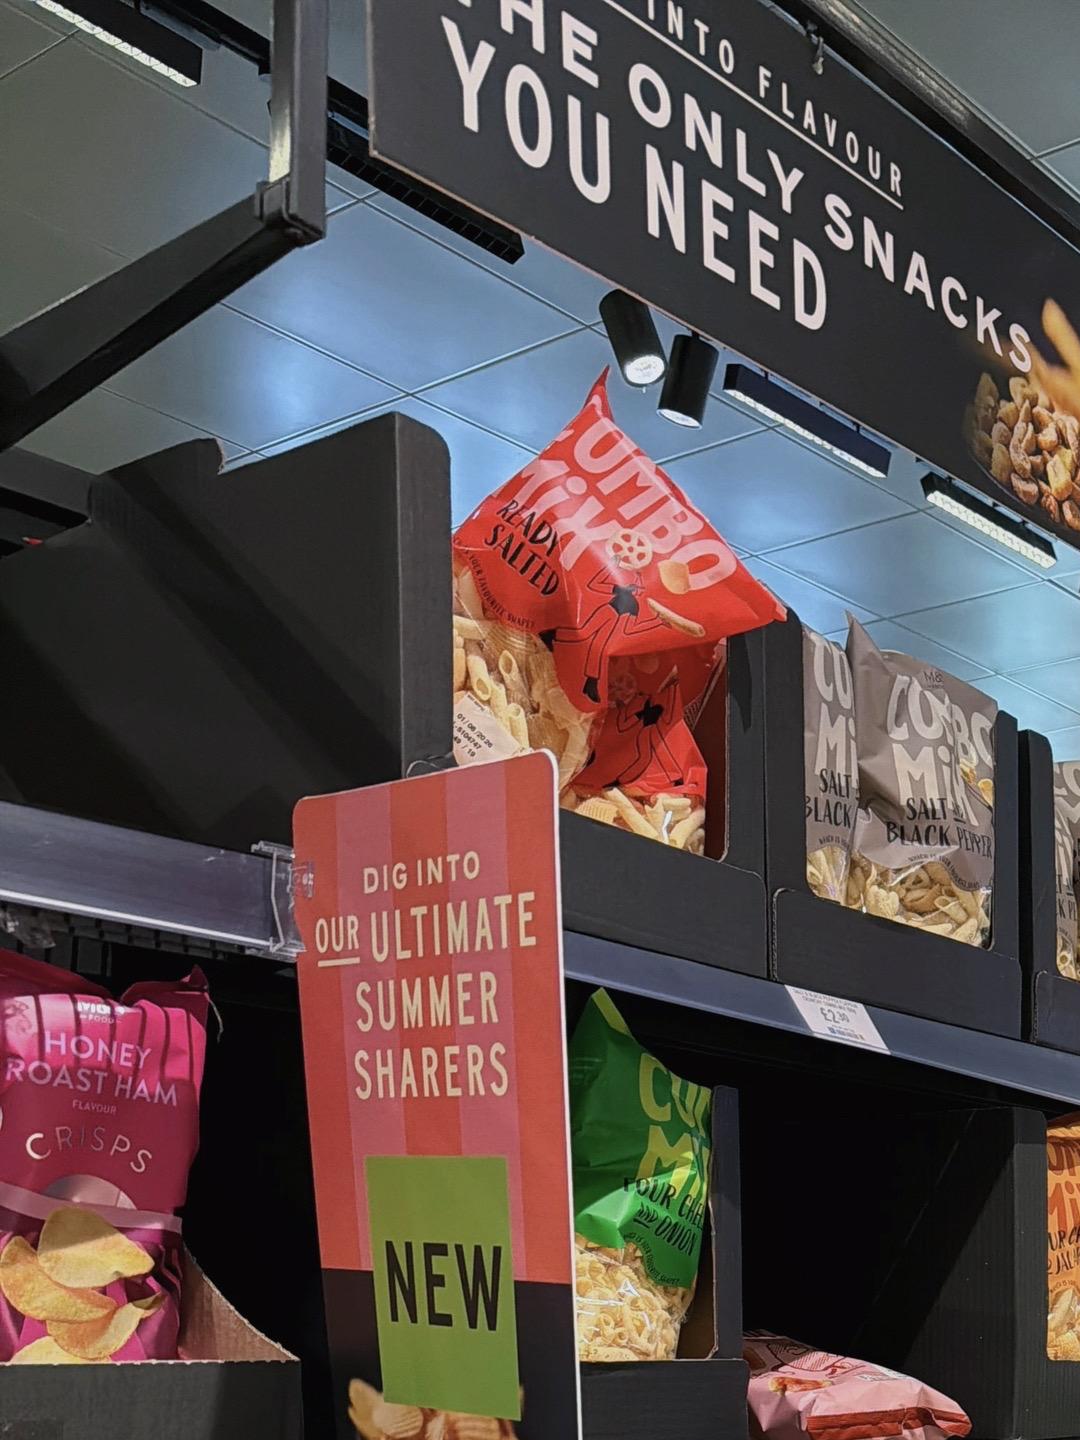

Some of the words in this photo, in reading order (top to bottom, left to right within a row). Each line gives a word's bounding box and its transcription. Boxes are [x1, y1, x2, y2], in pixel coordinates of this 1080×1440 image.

[647, 0, 735, 74] INTO
[758, 66, 902, 197] FLAVOUR
[441, 15, 611, 204] YOU
[645, 144, 827, 331] NEED
[457, 0, 598, 88] HE
[628, 63, 804, 214] ONLY
[824, 193, 1033, 374] SNACKS
[496, 498, 559, 558] READY
[485, 524, 560, 597] SALTED
[819, 768, 852, 799] SALT
[906, 797, 948, 821] SALT
[887, 820, 949, 847] BLACK
[956, 825, 993, 859] PEPPER
[363, 862, 408, 894] DIG
[417, 850, 481, 886] INTO
[315, 915, 360, 954] OUR
[371, 891, 537, 963] ULTIMATE
[355, 971, 498, 1033] SUMMER
[44, 1030, 153, 1069] HONEY
[354, 1042, 509, 1100] SHARERS
[6, 1058, 108, 1095] ROAST
[114, 1072, 178, 1107] HAM
[72, 1099, 117, 1116] FLAVOUR
[25, 1123, 153, 1173] CRISPS
[622, 1177, 677, 1211] FOUR
[654, 1216, 698, 1257] ONION
[385, 1240, 502, 1332] NEW
